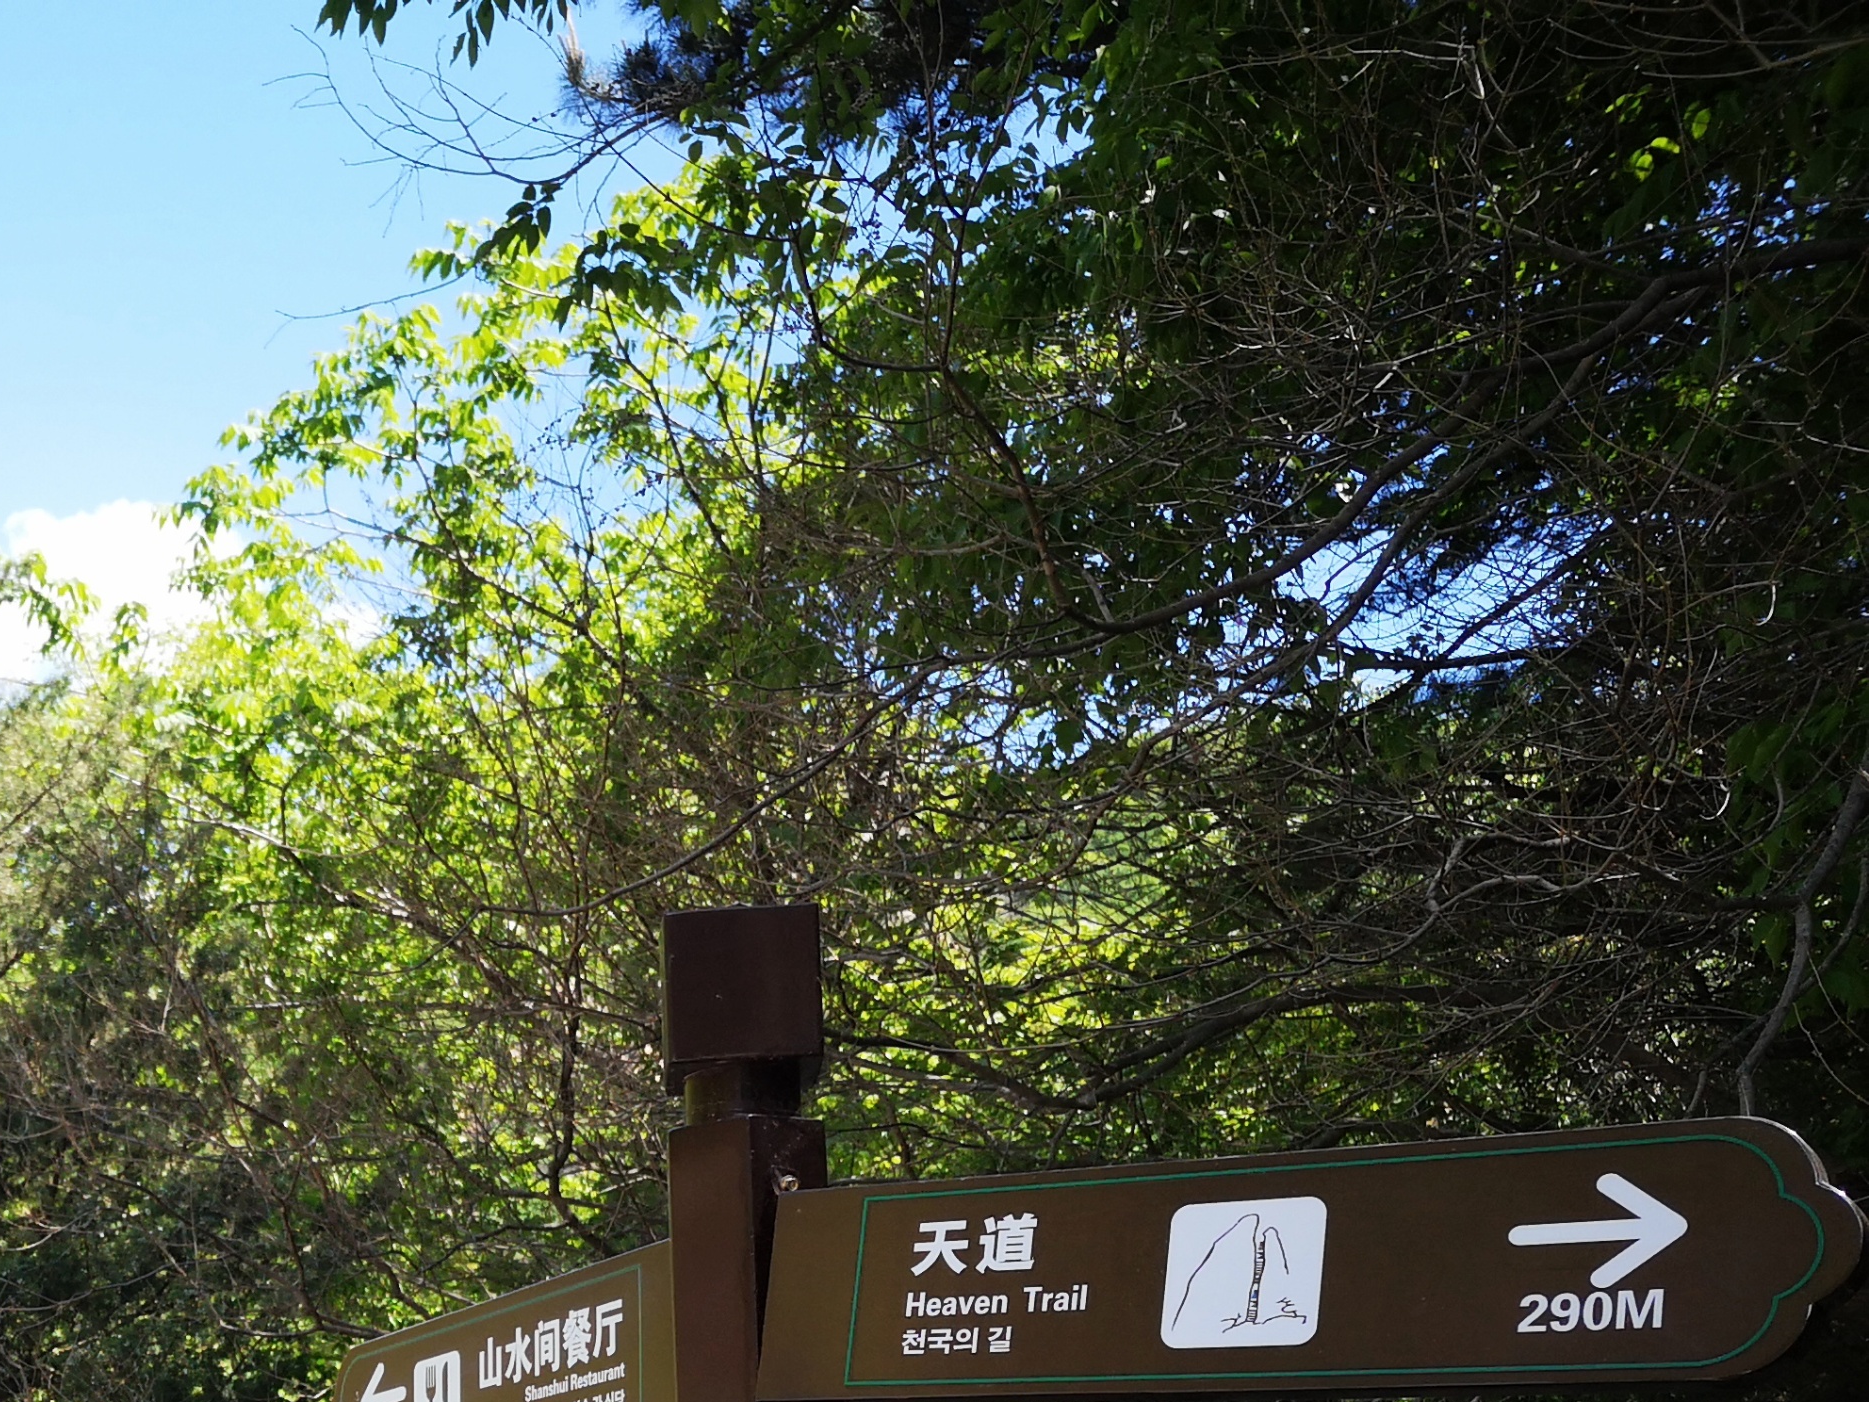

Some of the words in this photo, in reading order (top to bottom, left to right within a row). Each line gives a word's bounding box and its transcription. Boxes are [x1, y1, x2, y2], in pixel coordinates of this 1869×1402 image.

[910, 1212, 1038, 1277] 天道
[904, 1290, 1009, 1318] Heaven
[1023, 1284, 1089, 1313] Trail
[1516, 1287, 1666, 1334] 290M
[478, 1298, 623, 1389] 山水间餐厅
[901, 1327, 980, 1355] 천국의
[987, 1326, 1013, 1353] 길
[524, 1375, 569, 1402] Shanshui
[570, 1362, 626, 1391] Restaurant
